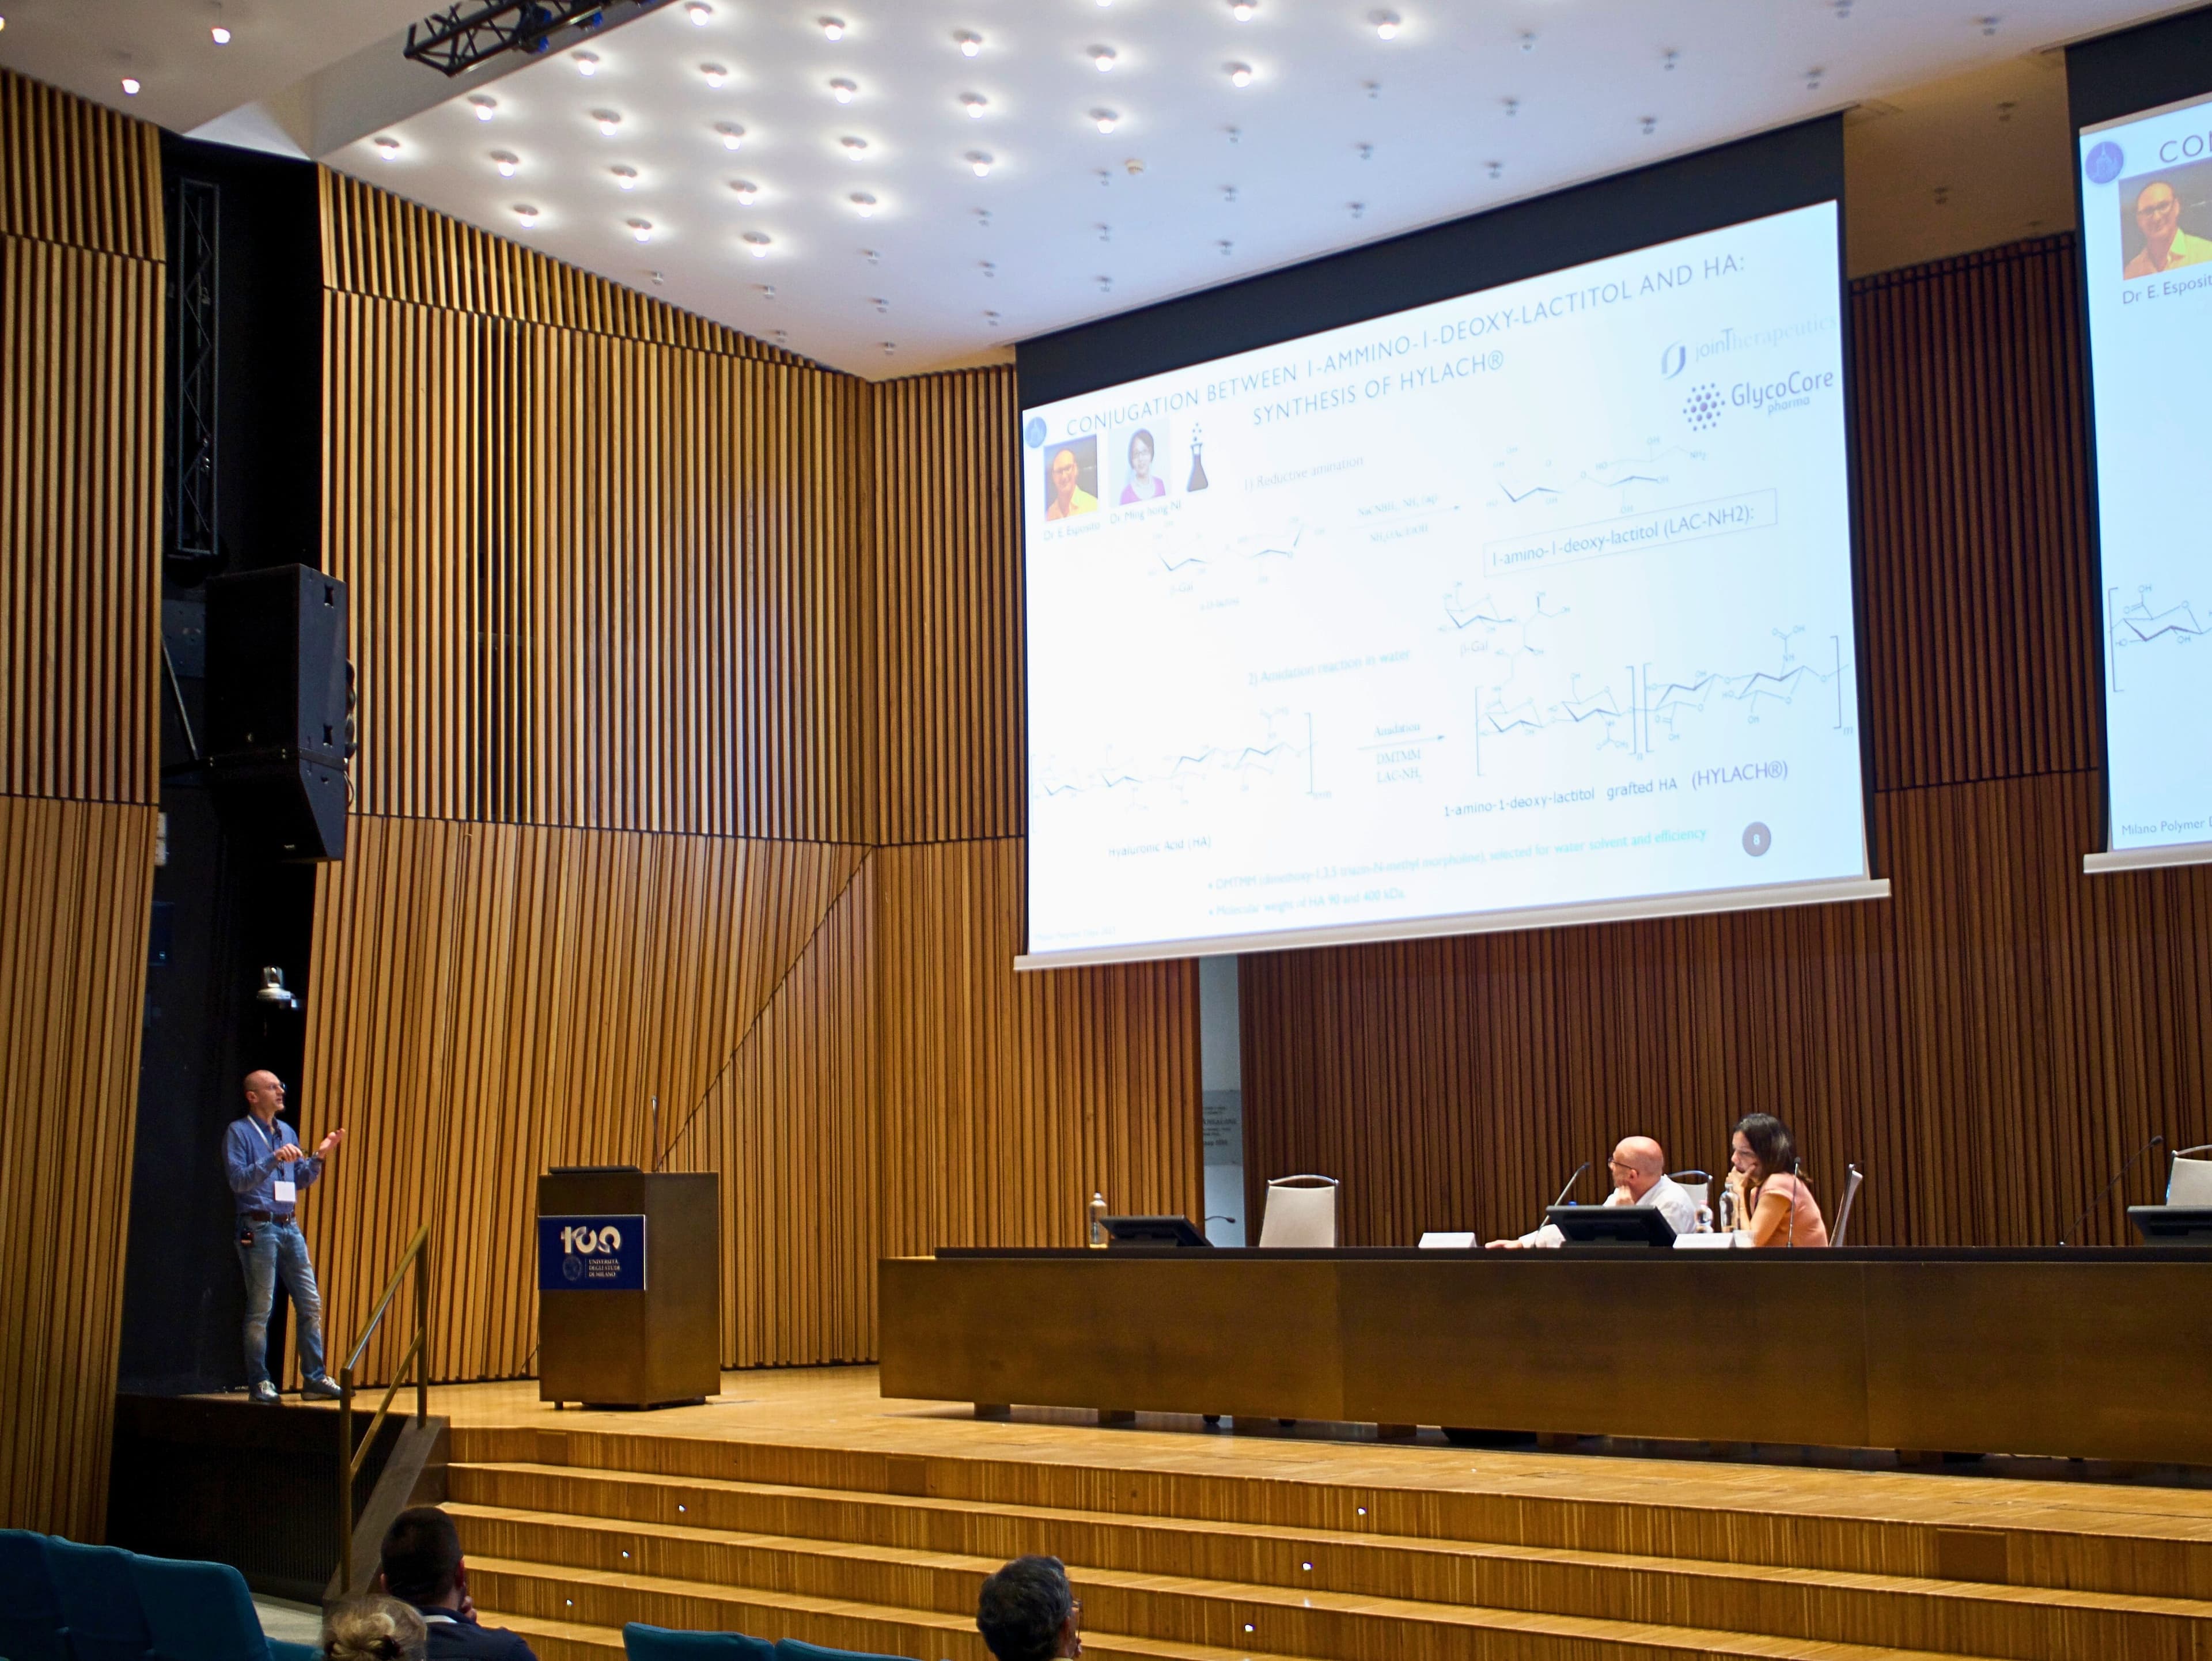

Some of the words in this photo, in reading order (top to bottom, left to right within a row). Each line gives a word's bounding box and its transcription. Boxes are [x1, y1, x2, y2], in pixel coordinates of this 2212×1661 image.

[2160, 130, 2212, 164] CO
[2123, 290, 2141, 305] Dr
[2147, 285, 2160, 299] E.
[1066, 388, 1199, 436] CONJUGATION
[1207, 364, 1297, 402] BETWEEN
[1640, 264, 1693, 296] AND
[1704, 253, 1745, 279] HA:
[1253, 385, 1356, 426] SYNTHESIS
[1365, 376, 1392, 399] OF
[1732, 370, 1834, 409] GlycoCore
[1768, 396, 1810, 415] pharma
[1257, 469, 1308, 489] Reductive
[1311, 456, 1365, 476] amination
[1664, 504, 1755, 539] (LAC-NH2):
[1444, 787, 1595, 817] 1-amino-1-deoxy-lactitol
[1607, 780, 1653, 801] grafted
[1658, 777, 1678, 792] HA
[1691, 760, 1789, 790] (HYLACH®)
[1535, 843, 1550, 856] for
[1554, 841, 1585, 854] water
[1589, 836, 1628, 850] solvent
[1631, 832, 1652, 846] and
[1654, 828, 1707, 844] efficiency
[2122, 823, 2157, 836] Milano
[2161, 819, 2206, 834] Polymer
[1165, 838, 1184, 851] Acid
